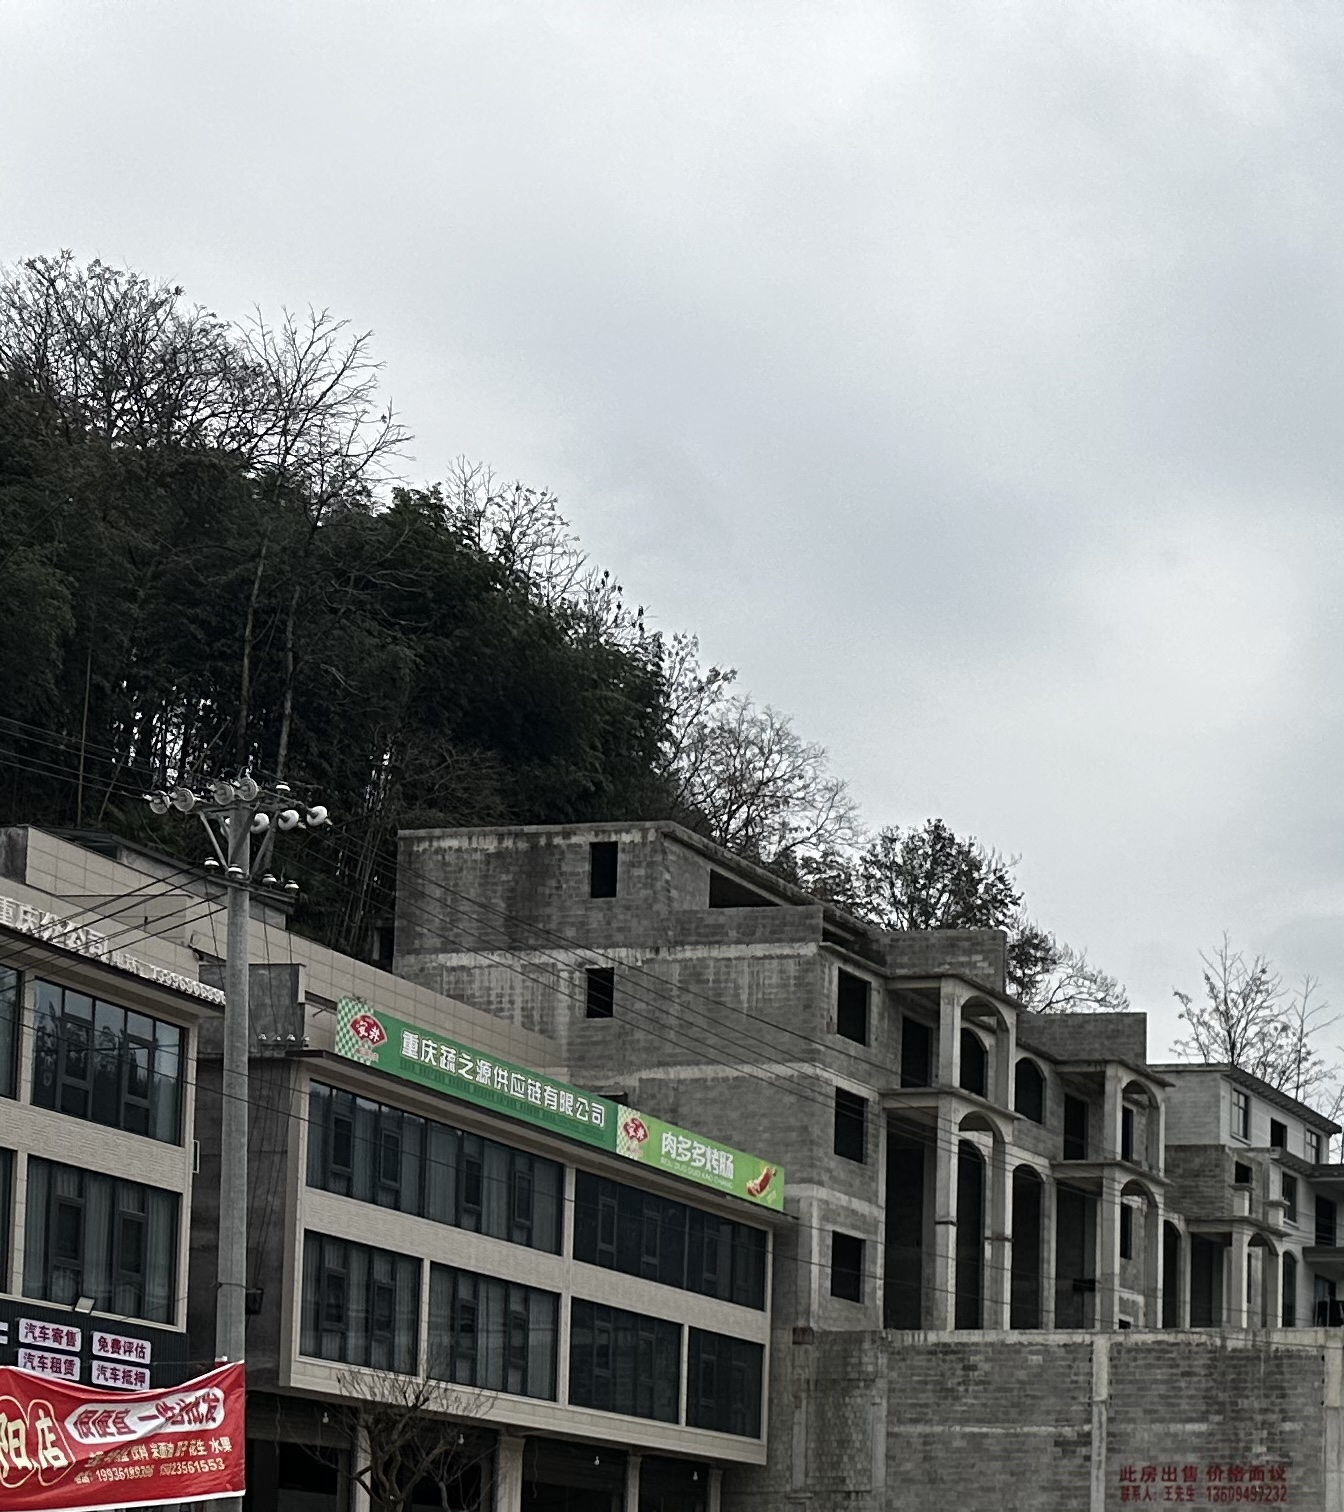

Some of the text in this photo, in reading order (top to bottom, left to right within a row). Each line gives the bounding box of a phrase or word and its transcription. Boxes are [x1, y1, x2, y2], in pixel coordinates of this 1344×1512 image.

[401, 1030, 606, 1128] 重庆蔬之源供应链有限公司
[660, 1131, 734, 1180] 肉多多烤肠
[24, 1321, 77, 1348] 汽车寄售
[97, 1335, 147, 1361] 免费评估
[23, 1351, 76, 1377] 汽车租赁
[96, 1363, 146, 1388] 汽车抵押
[1119, 1464, 1287, 1483] 此房出售 价格面议
